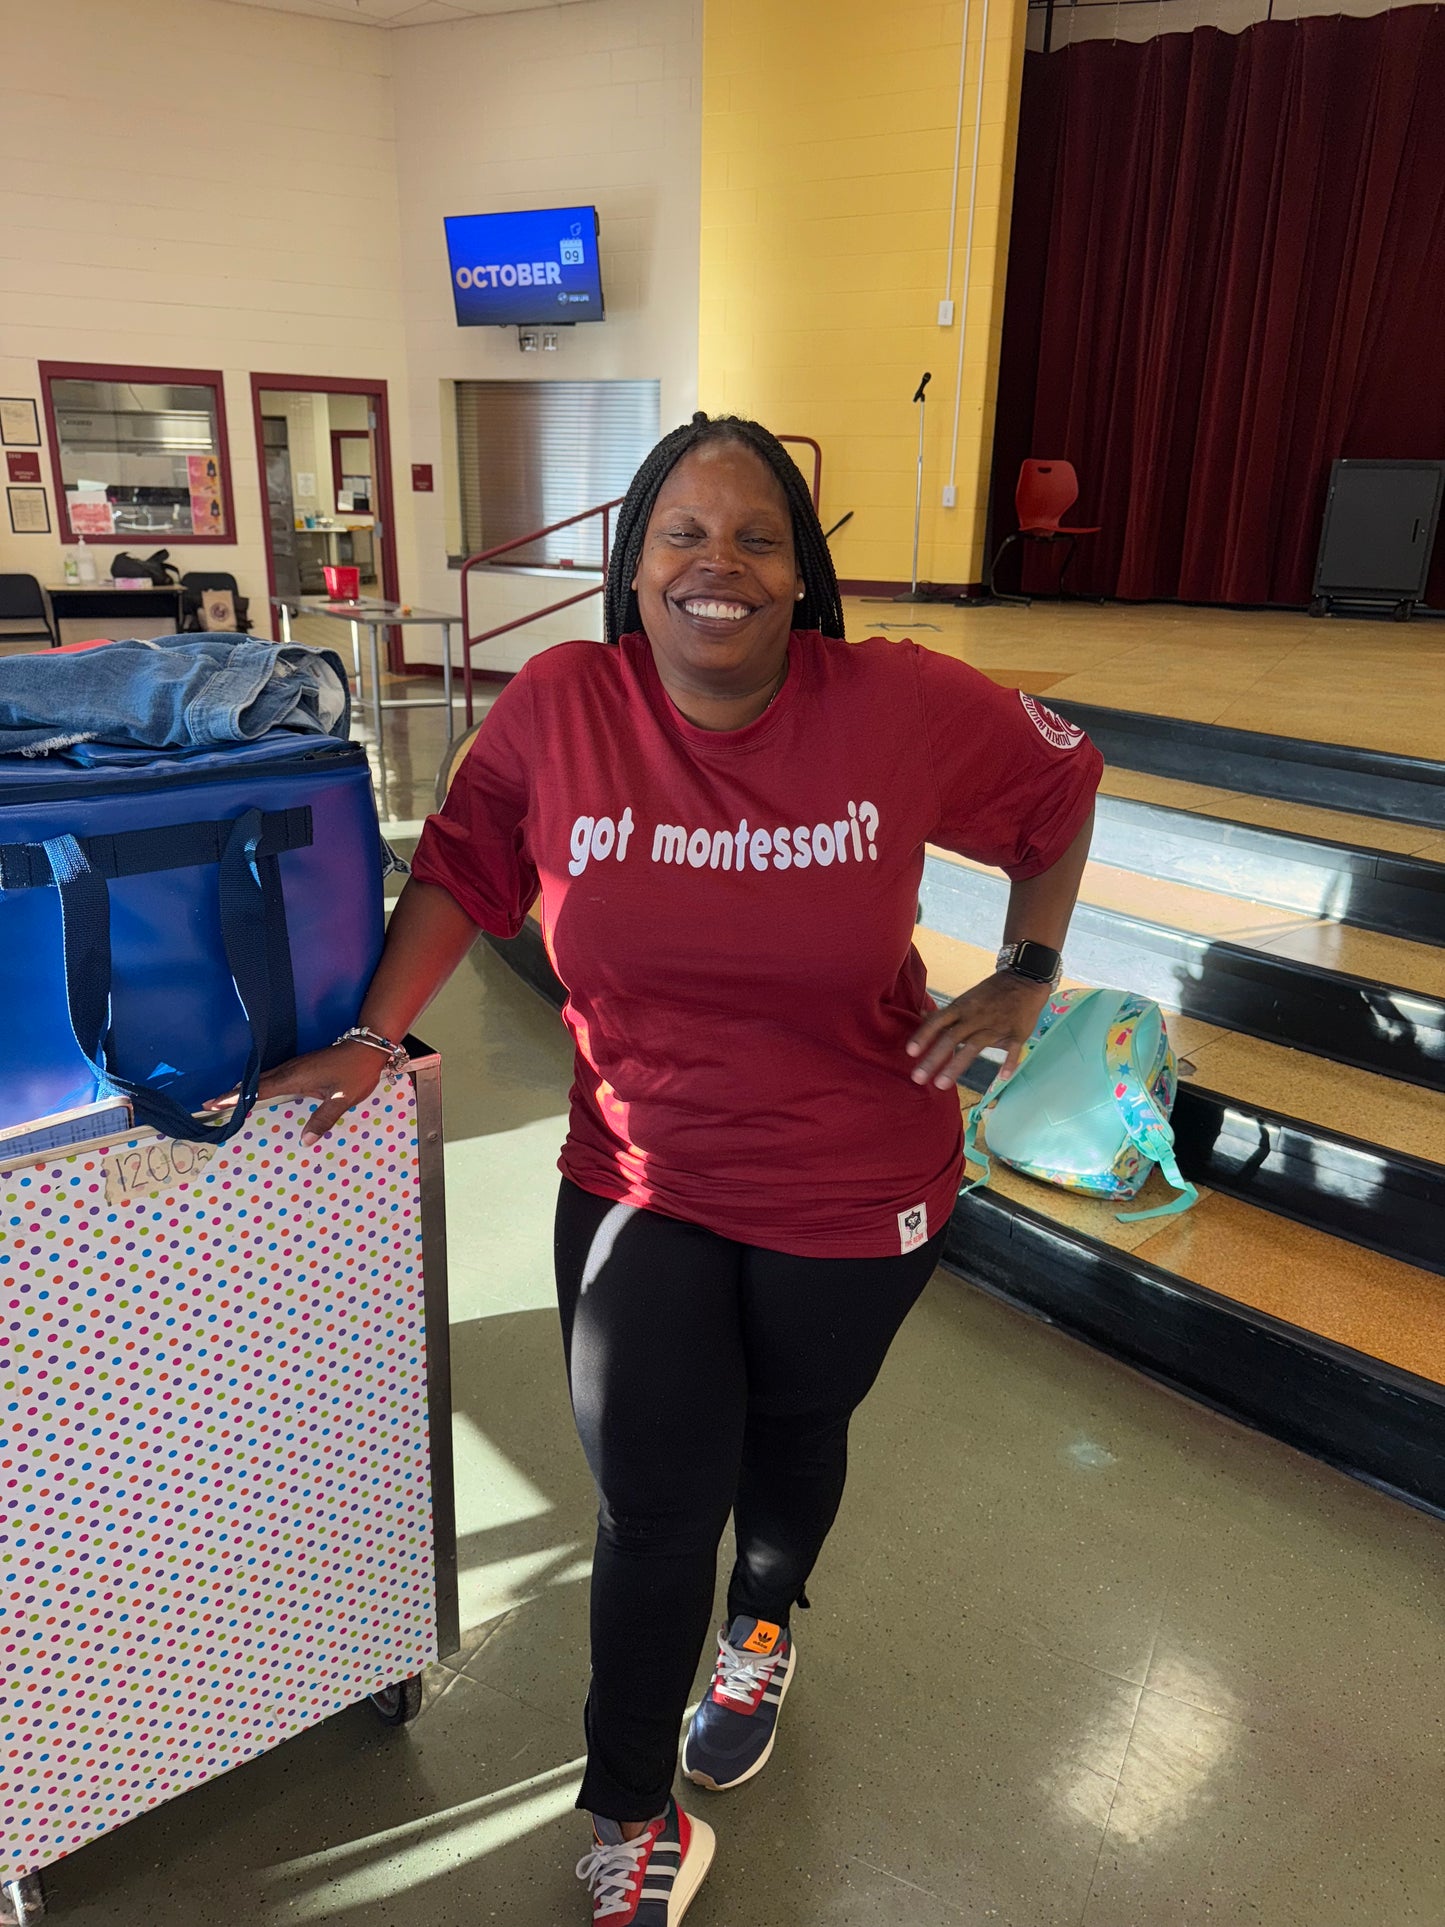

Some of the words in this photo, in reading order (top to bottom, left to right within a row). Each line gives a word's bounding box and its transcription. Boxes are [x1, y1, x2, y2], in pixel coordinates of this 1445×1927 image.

[564, 250, 579, 262] 09
[456, 262, 562, 289] OCTOBER
[1046, 729, 1071, 746] NORTH
[568, 806, 634, 877] got
[651, 800, 879, 871] montessori?
